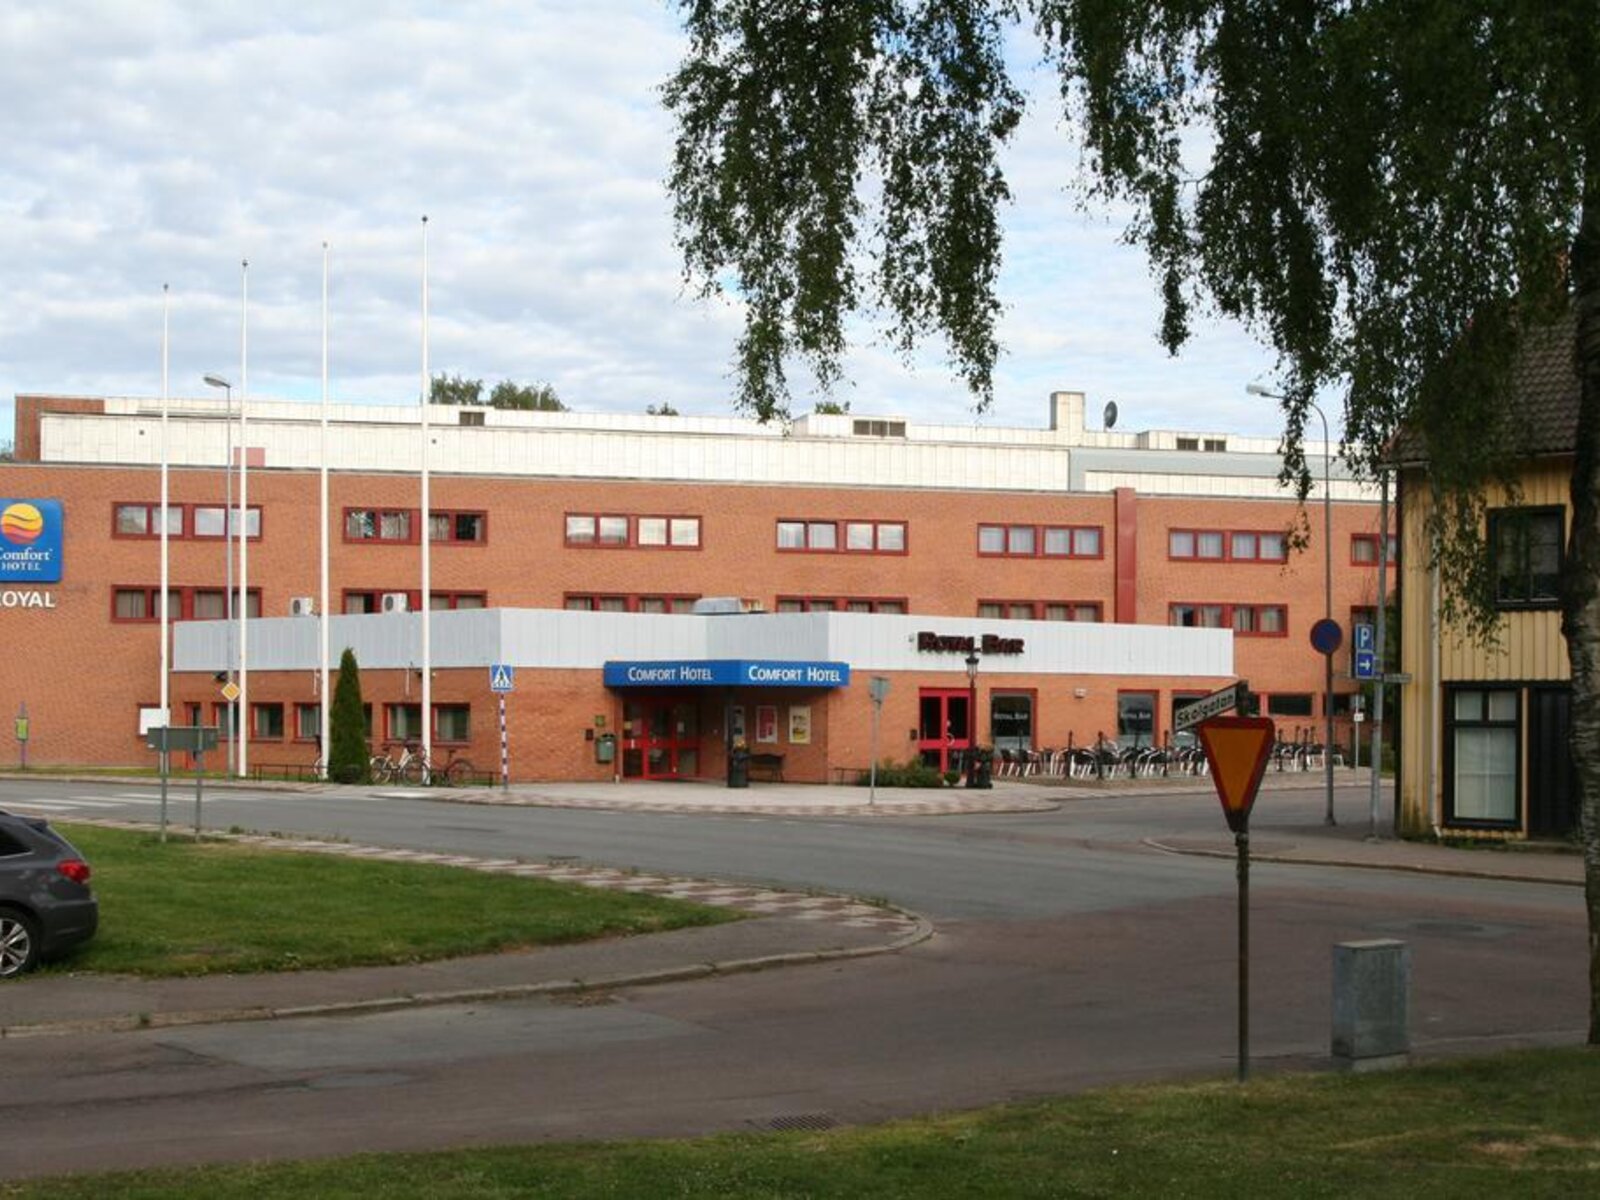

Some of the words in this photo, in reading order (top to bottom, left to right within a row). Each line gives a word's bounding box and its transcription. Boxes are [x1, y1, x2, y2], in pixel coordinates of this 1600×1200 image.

[1, 562, 42, 572] HOTEL
[0, 591, 55, 608] OYAL
[918, 632, 974, 653] ROYAL
[981, 634, 1024, 655] BAR
[1361, 627, 1370, 648] P
[628, 667, 676, 681] COMFORT
[680, 666, 713, 680] HOTEL
[749, 665, 801, 681] COMFORT
[807, 668, 841, 682] HOTEL
[1177, 694, 1234, 727] Skolgatan
